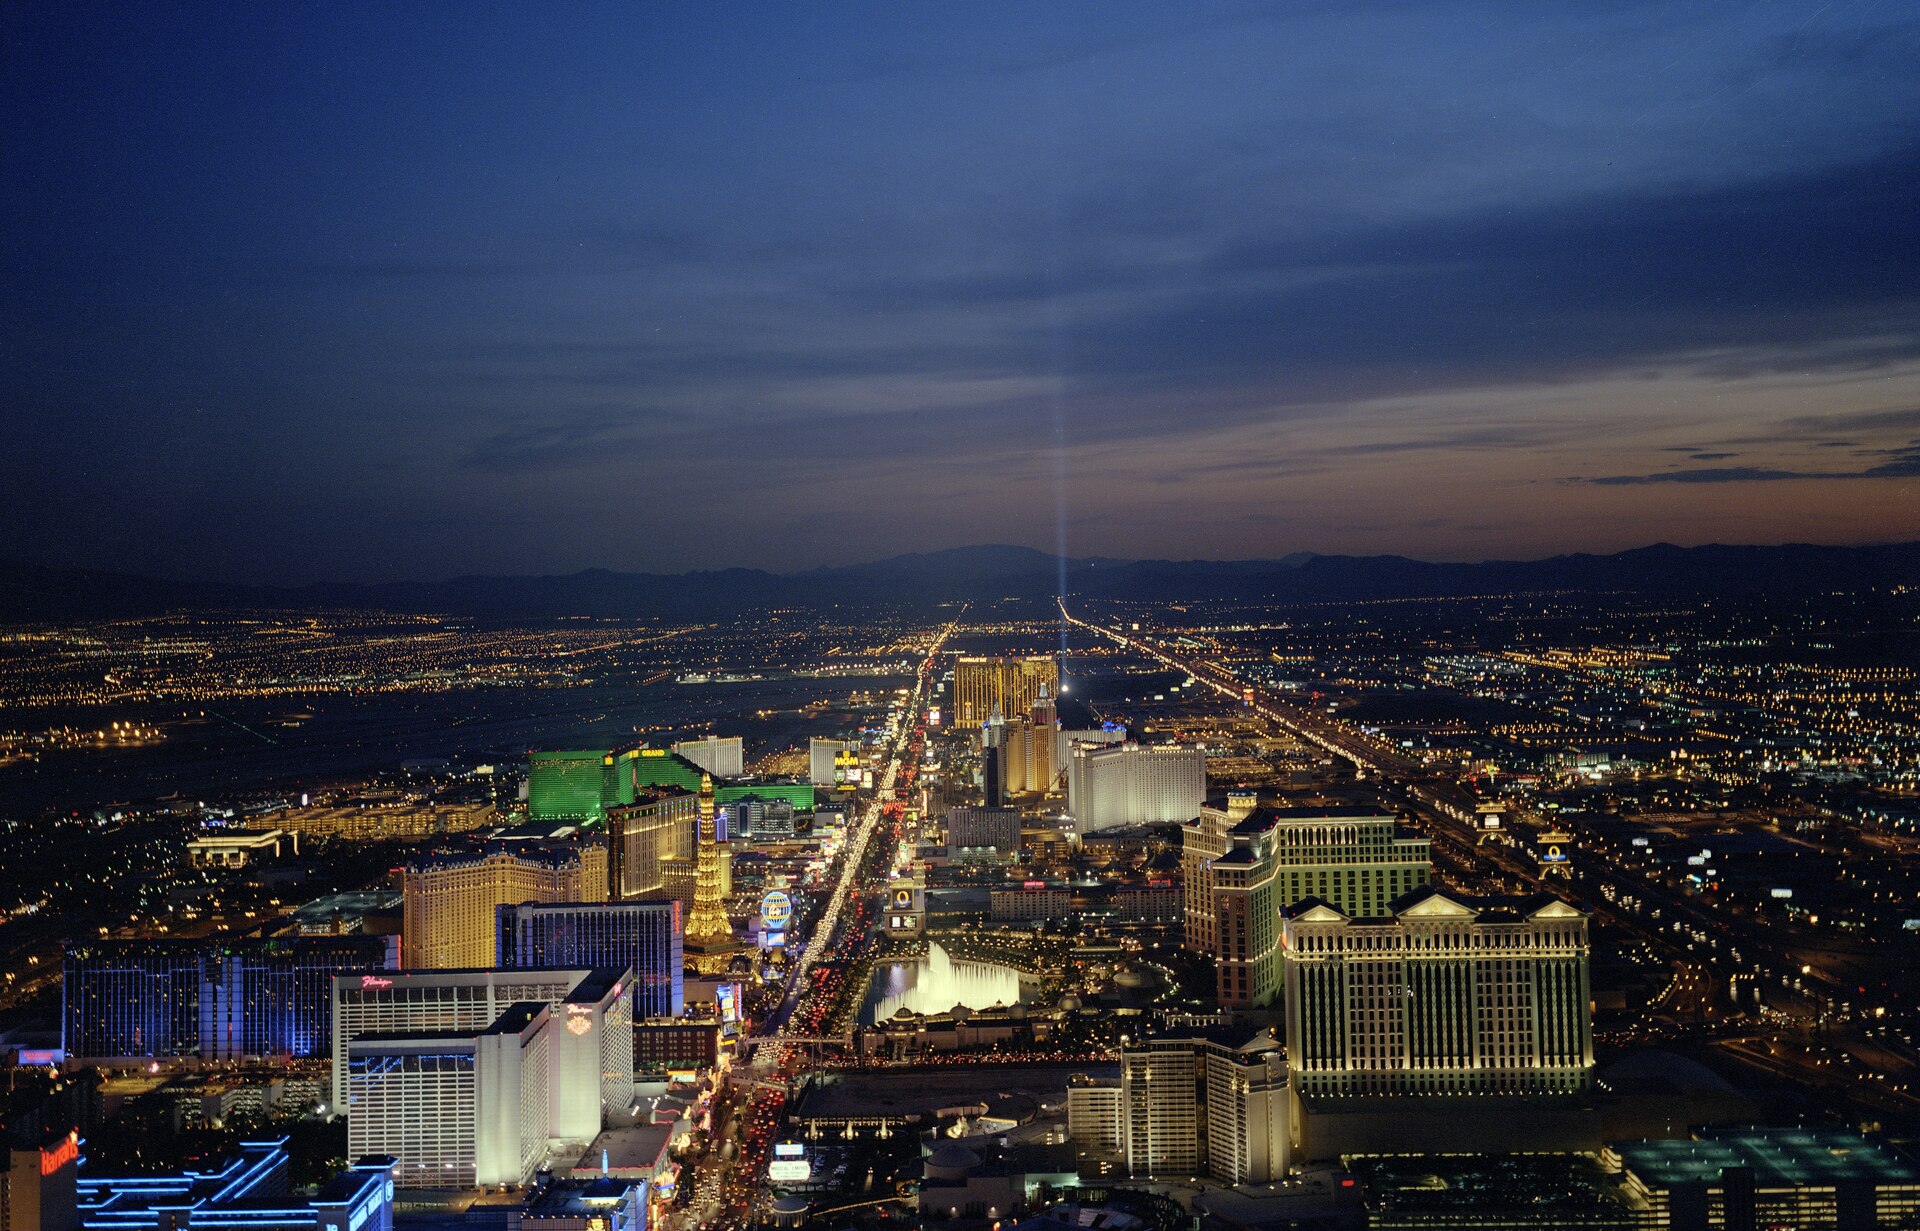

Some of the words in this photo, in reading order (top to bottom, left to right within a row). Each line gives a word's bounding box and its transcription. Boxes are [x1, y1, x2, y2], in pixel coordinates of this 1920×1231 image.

[641, 749, 665, 757] GRAND
[834, 757, 858, 766] MGM
[896, 890, 909, 905] O
